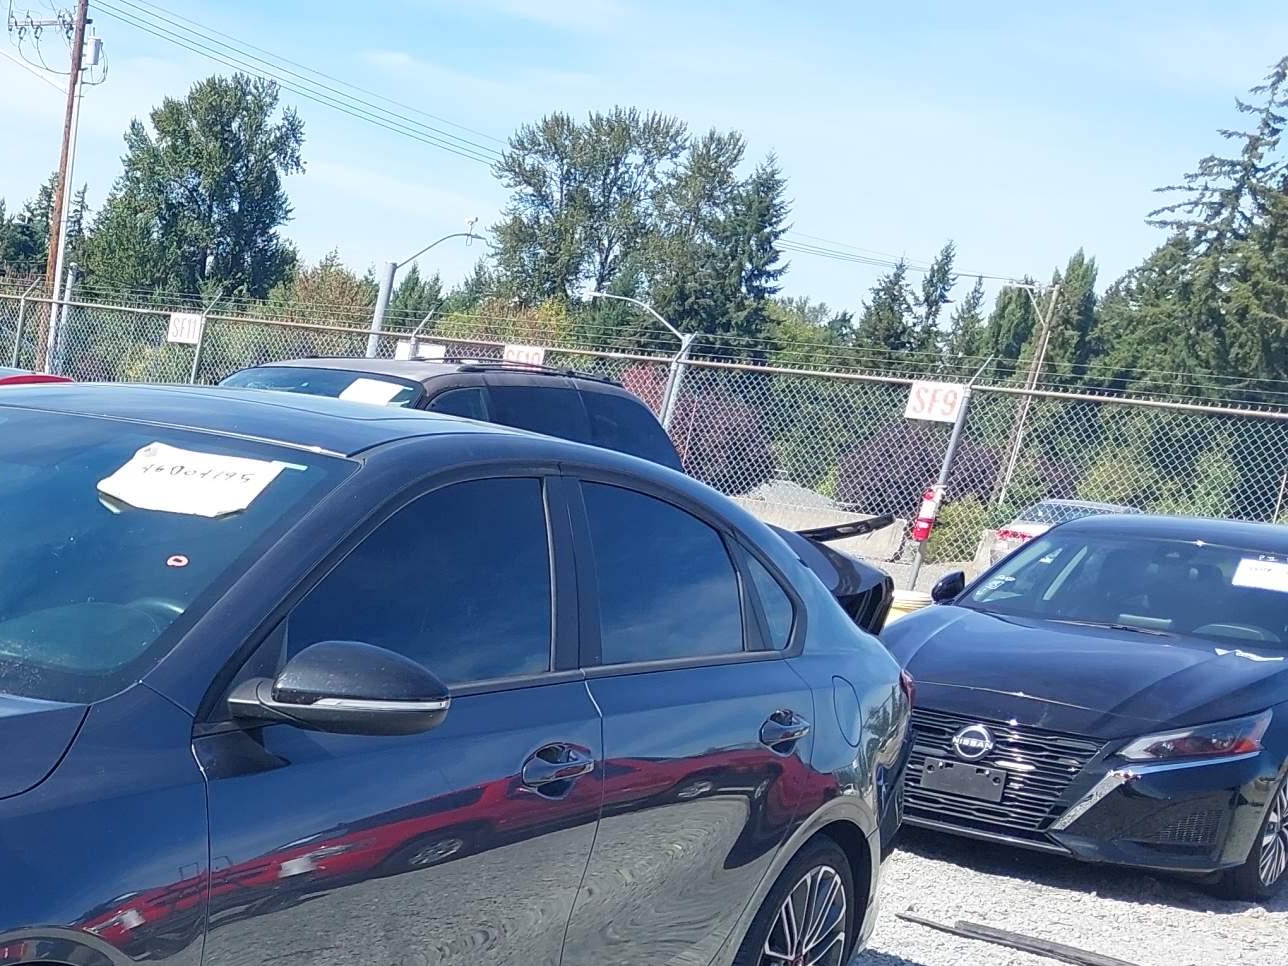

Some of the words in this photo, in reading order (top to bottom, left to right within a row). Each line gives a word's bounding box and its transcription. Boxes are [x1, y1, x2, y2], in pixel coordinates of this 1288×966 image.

[172, 317, 198, 339] SF11
[912, 386, 958, 416] SF9
[952, 735, 993, 750] NISSAN
